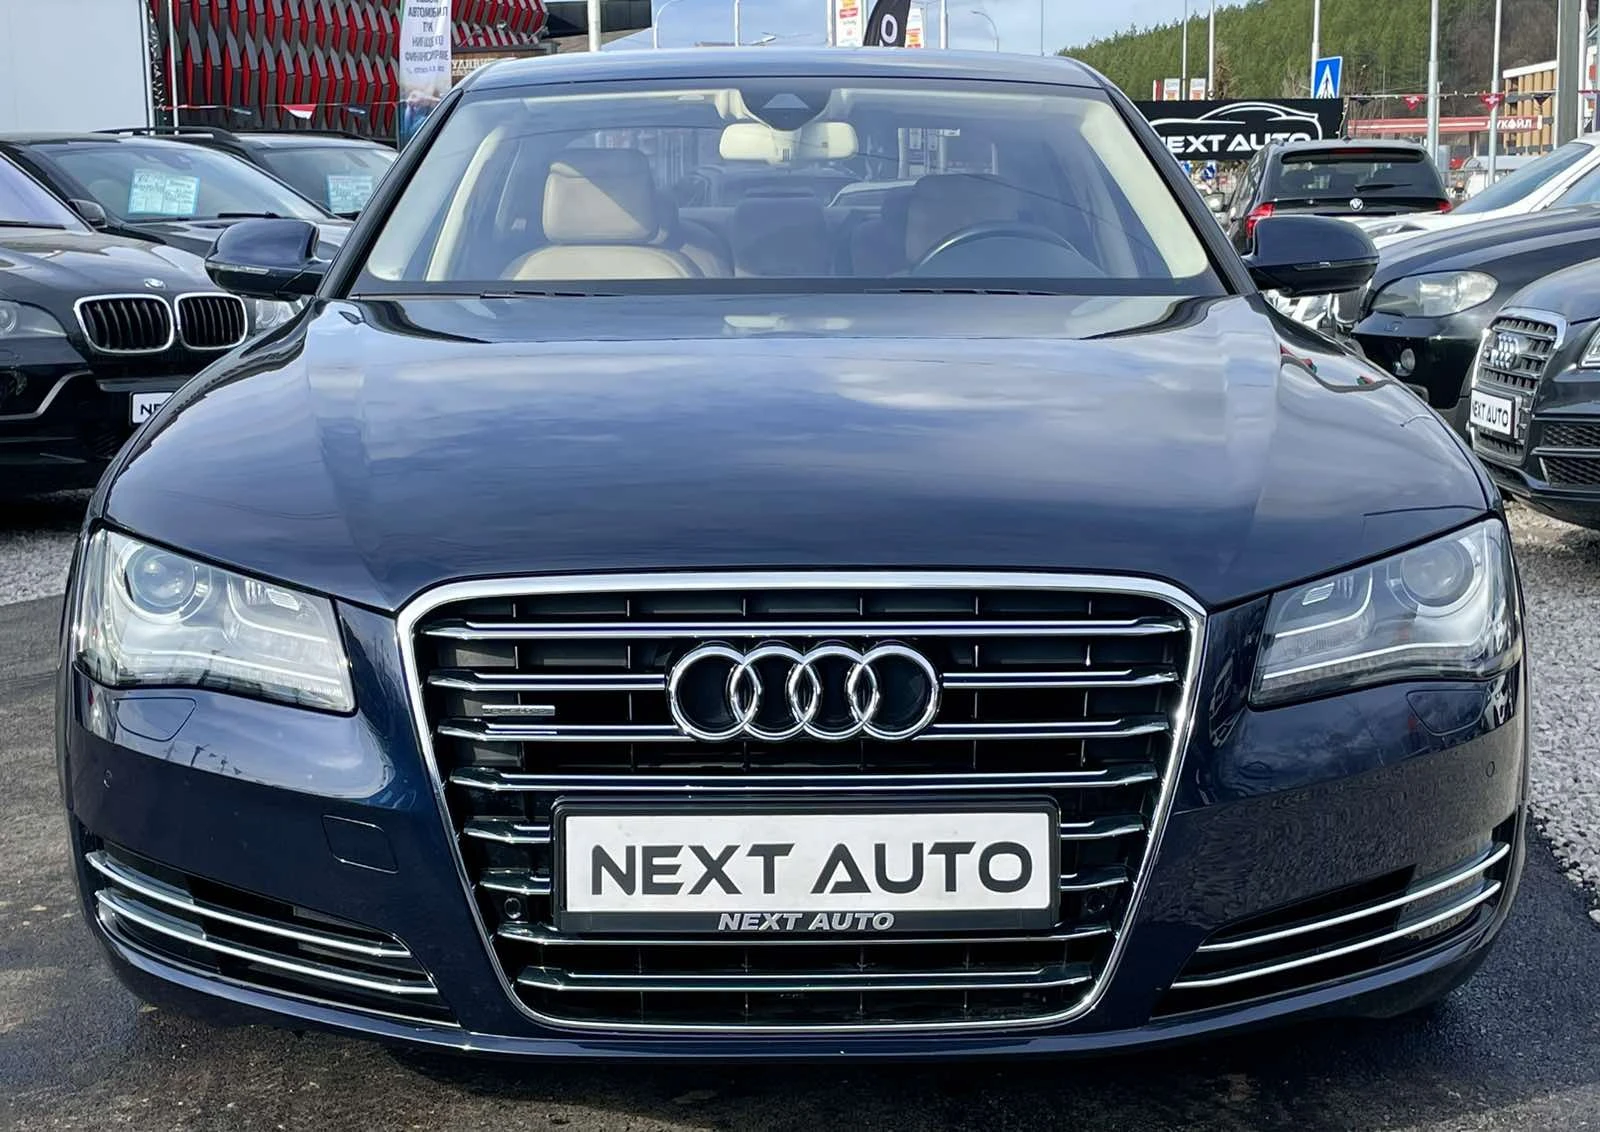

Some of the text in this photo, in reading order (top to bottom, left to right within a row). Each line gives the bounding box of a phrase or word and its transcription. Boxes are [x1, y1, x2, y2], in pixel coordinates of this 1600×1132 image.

[1487, 406, 1509, 427] AUTO
[591, 841, 1033, 896] NEXT AUTO
[718, 912, 895, 931] NEXT AUTO
